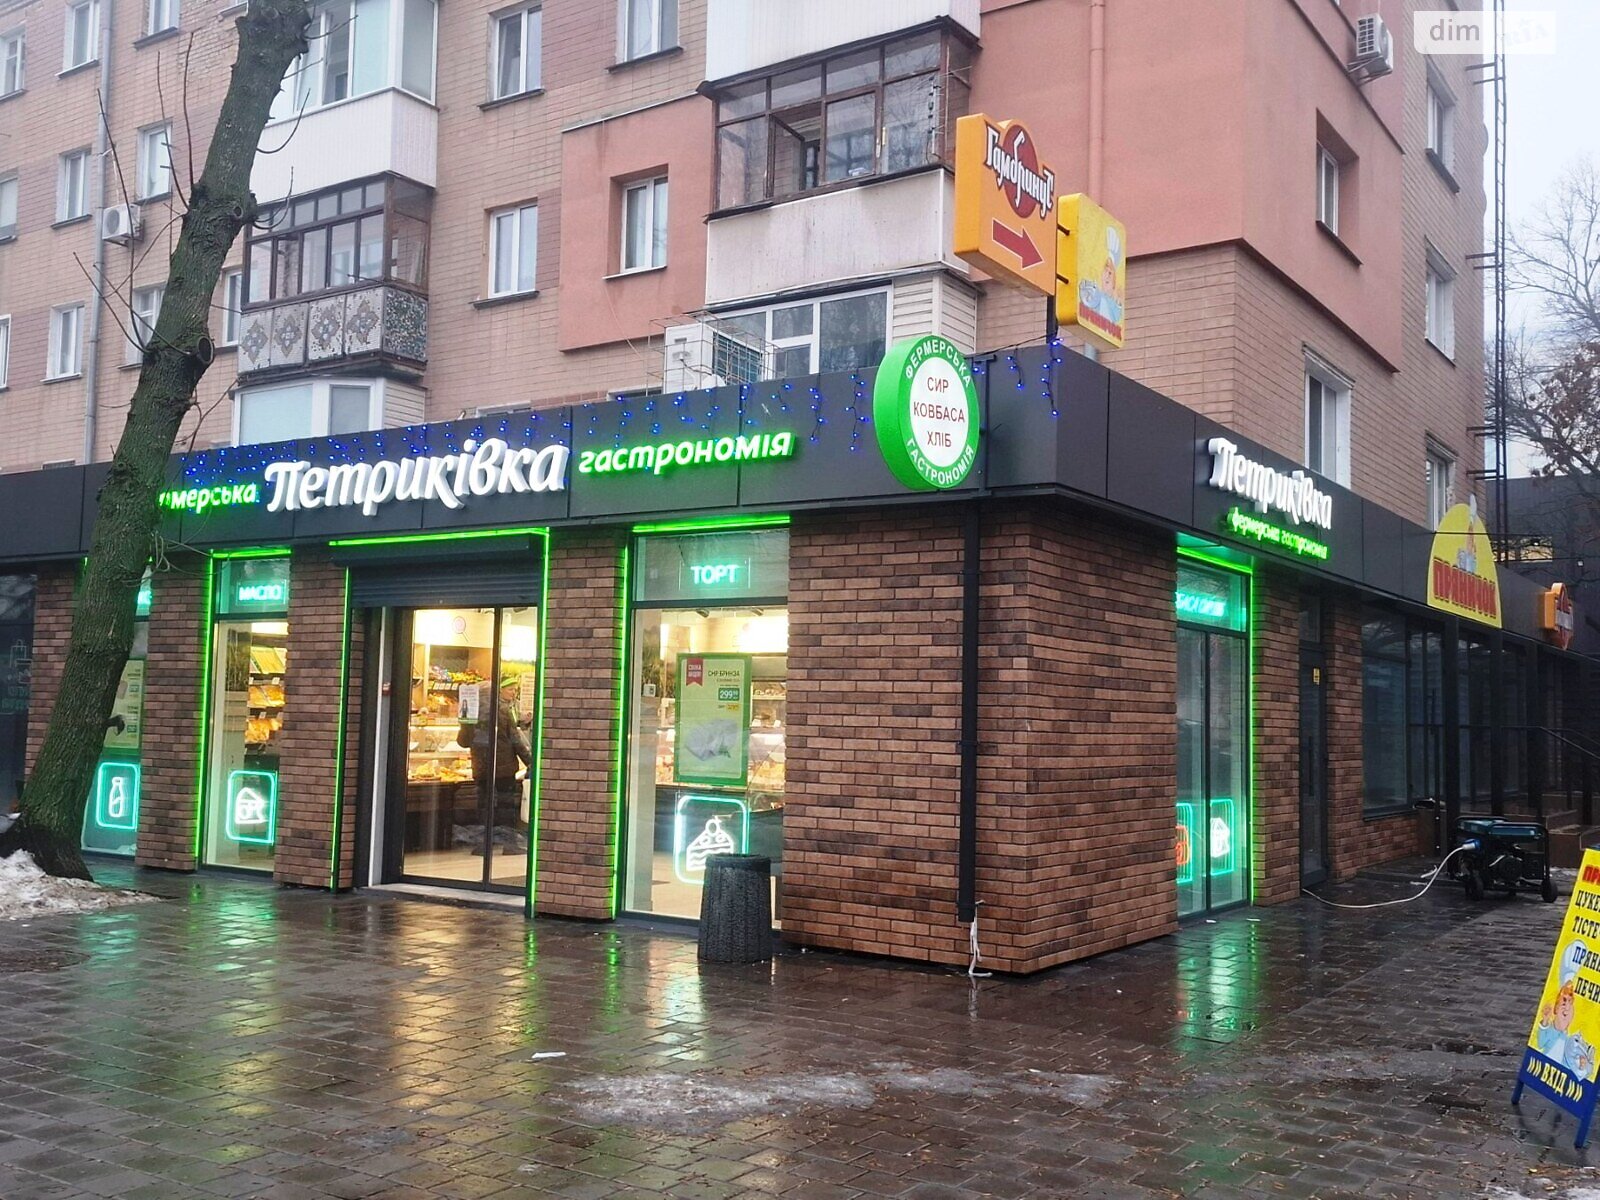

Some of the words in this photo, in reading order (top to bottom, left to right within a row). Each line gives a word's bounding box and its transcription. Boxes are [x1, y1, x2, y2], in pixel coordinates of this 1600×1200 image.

[905, 339, 972, 388] ФЕРМЕРСЬКА
[926, 376, 949, 393] СИР
[913, 401, 966, 423] КОВБАСА
[926, 430, 952, 448] ХЛІБ
[159, 482, 257, 514] мерська
[264, 437, 570, 516] Петриківка
[578, 431, 794, 476] гастрономія
[905, 438, 974, 485] ГАСТРОНОМІЯ
[1208, 437, 1333, 530] Петриківка
[690, 563, 740, 585] ТОРТ
[1575, 889, 1600, 913] ЦУКЕ
[1572, 915, 1600, 939] ТІСТЕ
[1574, 976, 1600, 1004] ПЕЧИ
[1540, 1063, 1568, 1097] ВХІД
